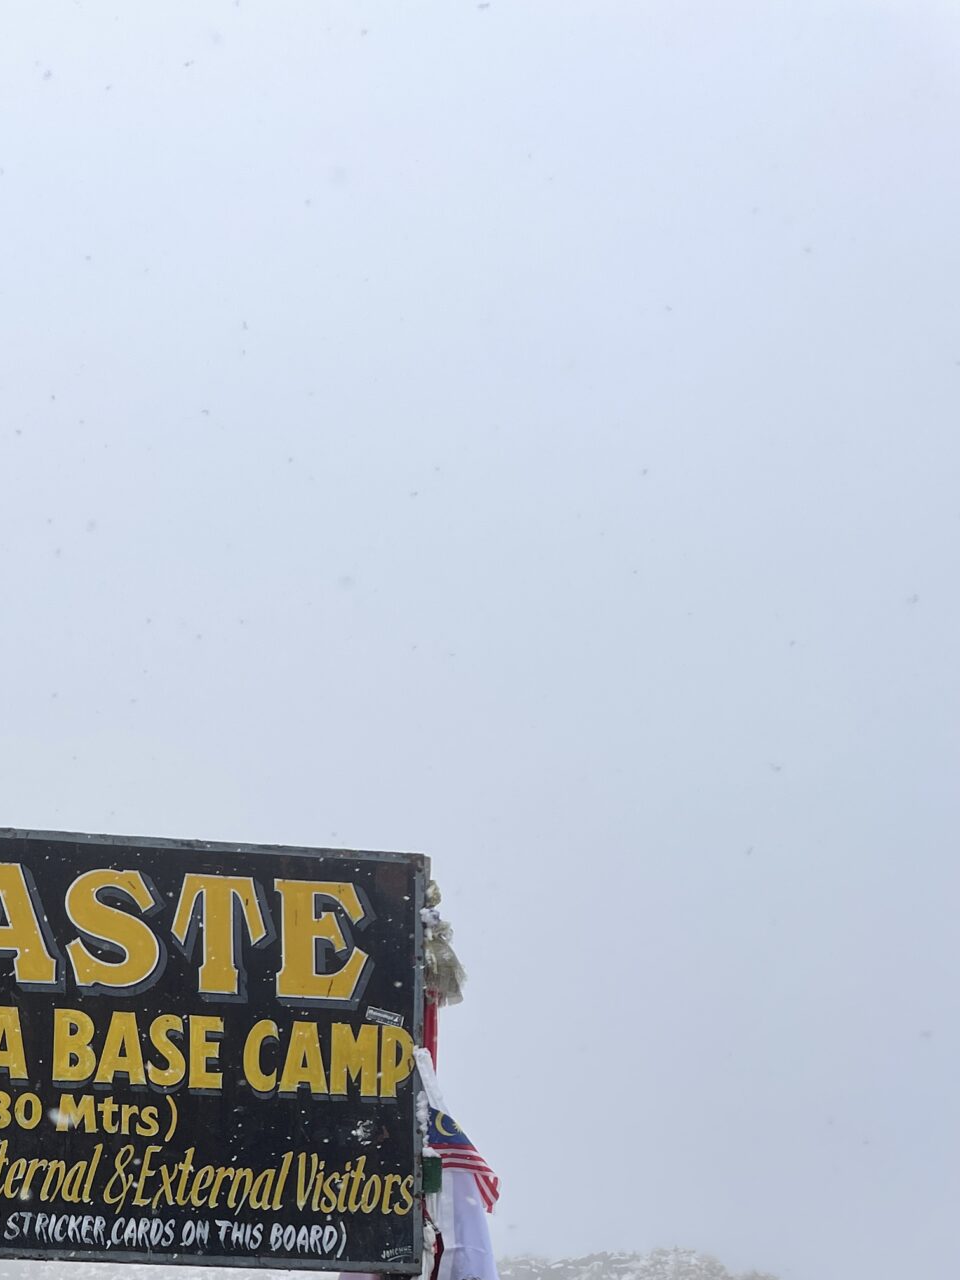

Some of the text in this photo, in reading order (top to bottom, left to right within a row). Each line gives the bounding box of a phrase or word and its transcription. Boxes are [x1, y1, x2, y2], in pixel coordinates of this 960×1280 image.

[52, 1007, 225, 1090] BASE
[242, 1018, 415, 1099] CAMP
[55, 1093, 178, 1142] Mtrs)
[297, 1151, 415, 1216] Visitors
[179, 1219, 210, 1247] ON
[214, 1219, 263, 1250] THIS
[269, 1220, 348, 1258] BOARD)
